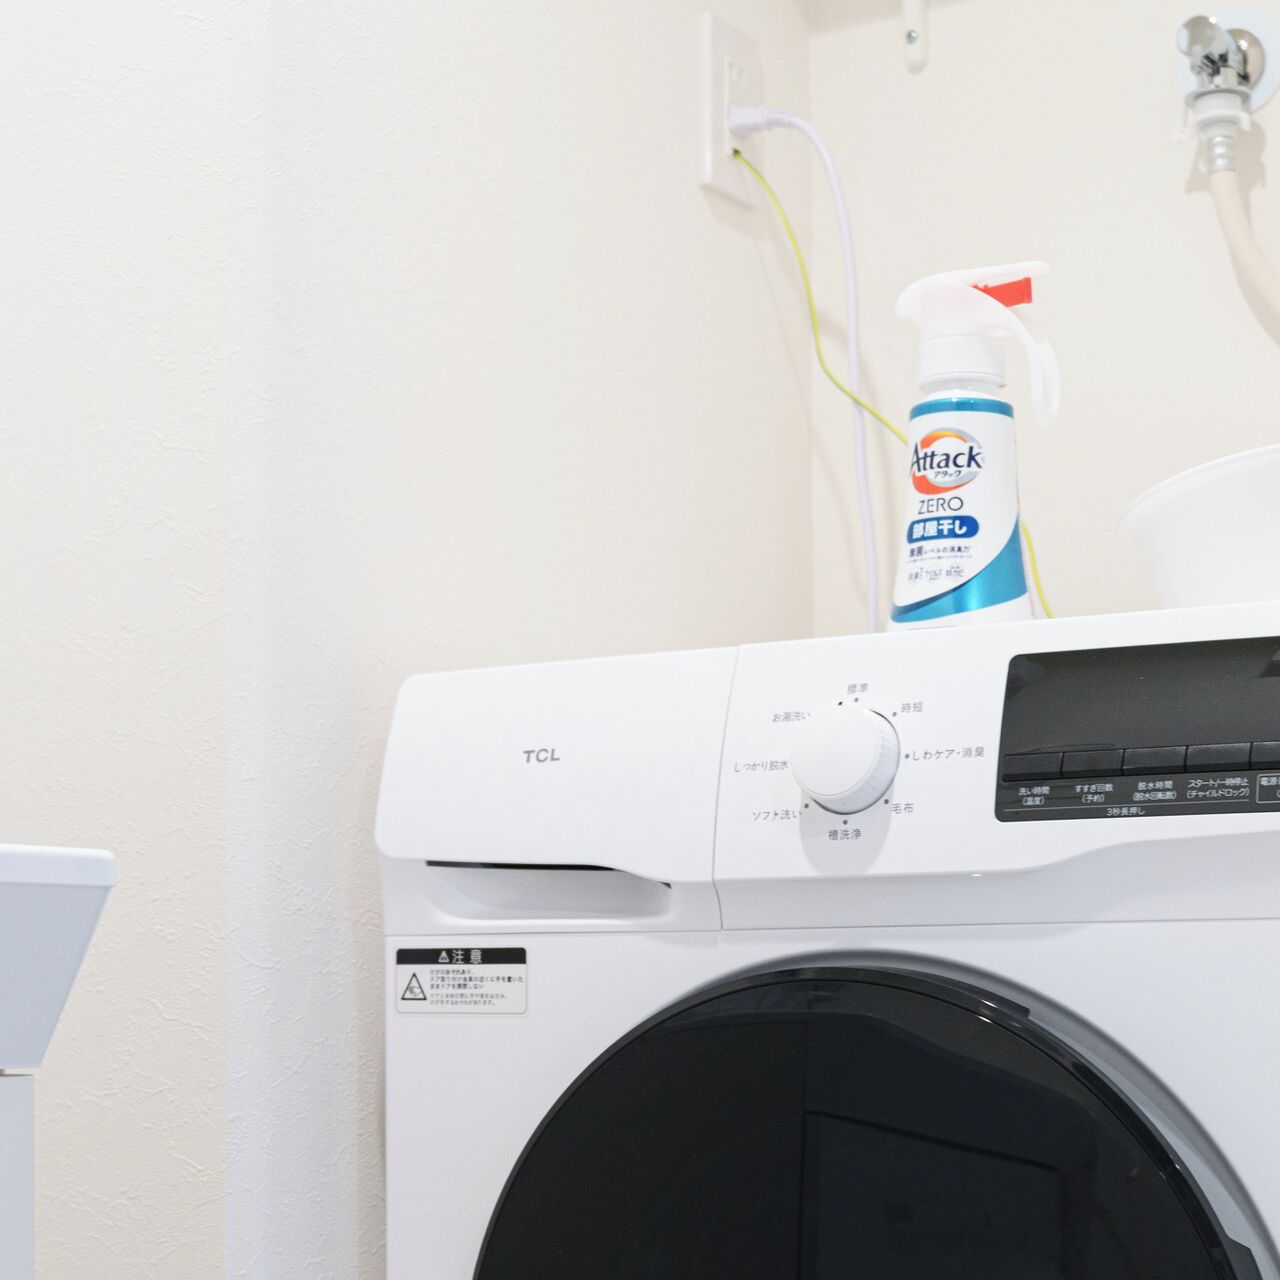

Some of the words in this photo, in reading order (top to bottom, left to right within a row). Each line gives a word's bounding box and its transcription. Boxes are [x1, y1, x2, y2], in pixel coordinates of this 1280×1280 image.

[910, 442, 982, 477] Attack
[934, 470, 962, 479] アタック
[918, 496, 964, 515] ZERO
[912, 519, 968, 540] 部屋干し
[847, 683, 869, 694] 標準
[901, 702, 924, 713] 時短
[523, 748, 560, 764] TCL
[734, 759, 789, 773] しっかり脱水
[1137, 780, 1174, 791] 脱水時間
[891, 803, 914, 814] 毛布
[1106, 806, 1146, 816] 3秒長押し
[752, 809, 803, 821] ソフト洗い
[828, 828, 862, 841] 槽洗浄
